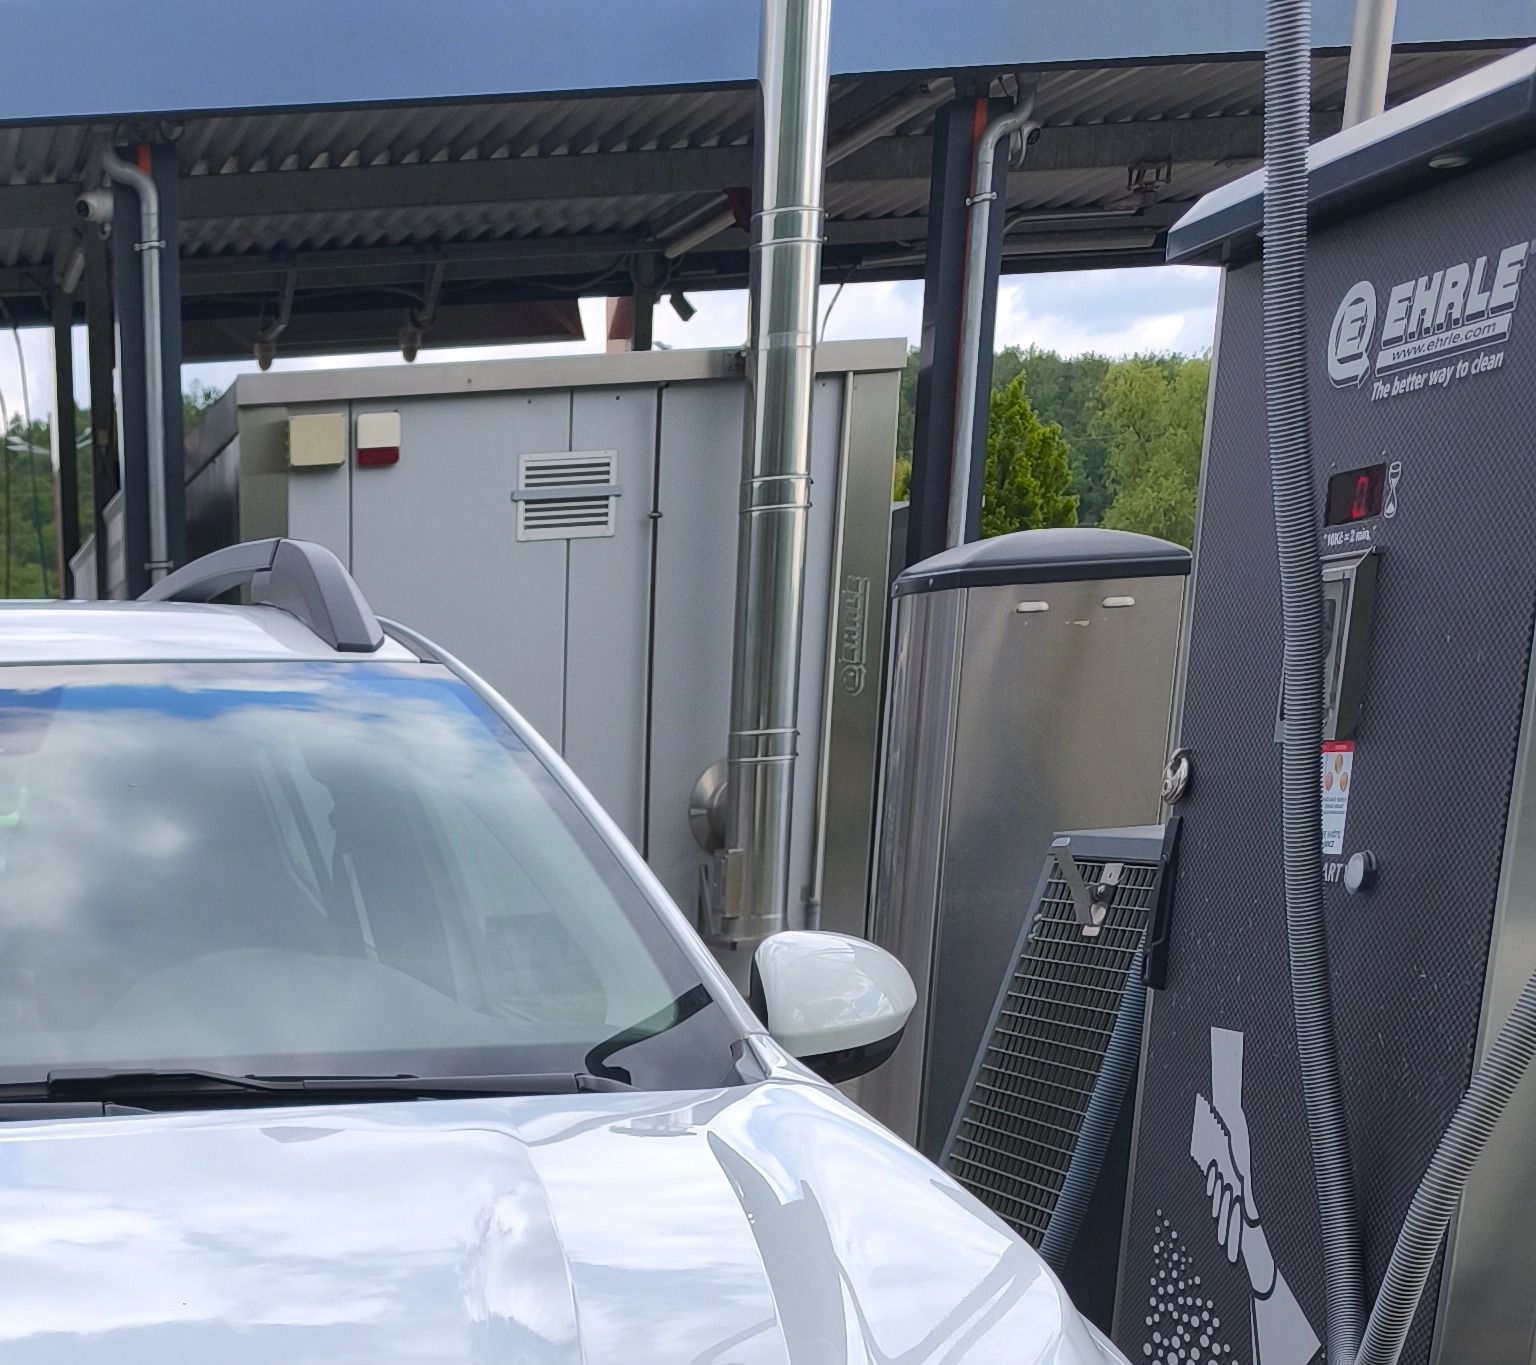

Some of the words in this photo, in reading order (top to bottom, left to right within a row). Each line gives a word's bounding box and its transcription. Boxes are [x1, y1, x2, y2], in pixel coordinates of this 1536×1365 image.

[1381, 241, 1530, 350] EHRLE
[1391, 321, 1497, 362] www.ehrle.com
[1371, 378, 1389, 401] The
[1390, 370, 1426, 397] better
[1428, 363, 1455, 388] way
[1456, 358, 1469, 379] to
[1470, 351, 1505, 375] clean
